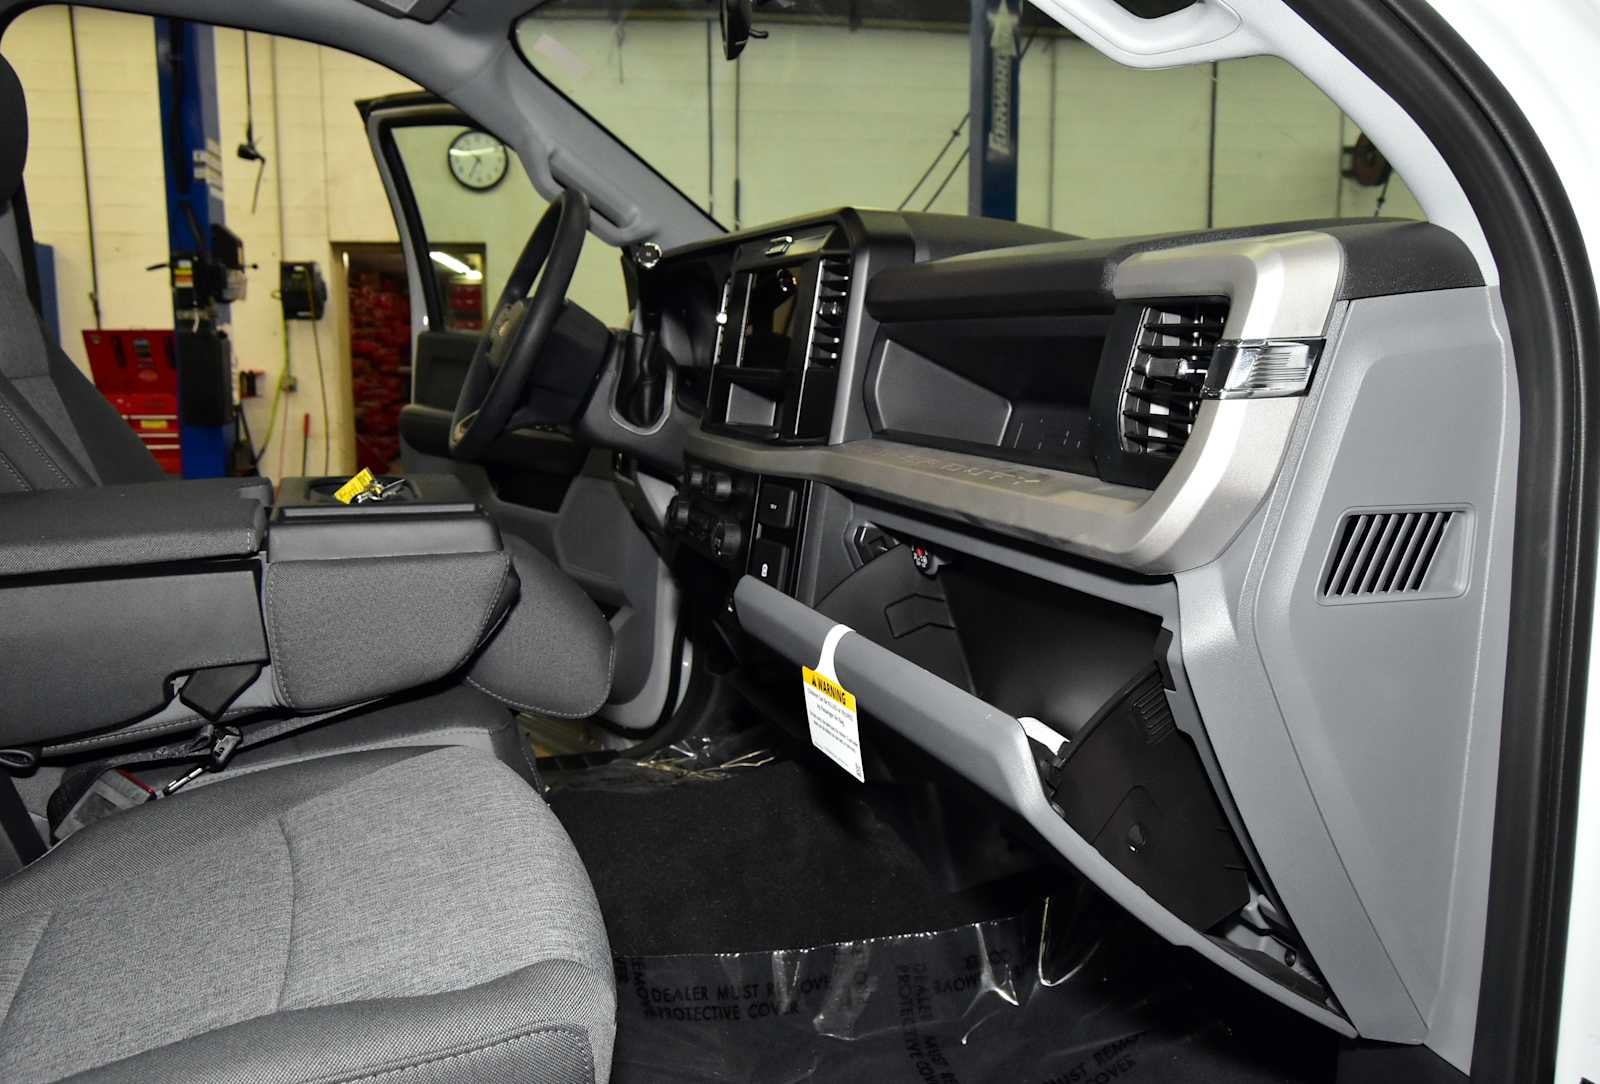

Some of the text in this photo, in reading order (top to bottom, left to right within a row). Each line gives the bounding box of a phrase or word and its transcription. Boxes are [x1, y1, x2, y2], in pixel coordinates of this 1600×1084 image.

[817, 677, 847, 706] WARNING
[651, 985, 709, 1003] DEALER
[717, 983, 761, 1001] MUST
[748, 1000, 800, 1019] COVR
